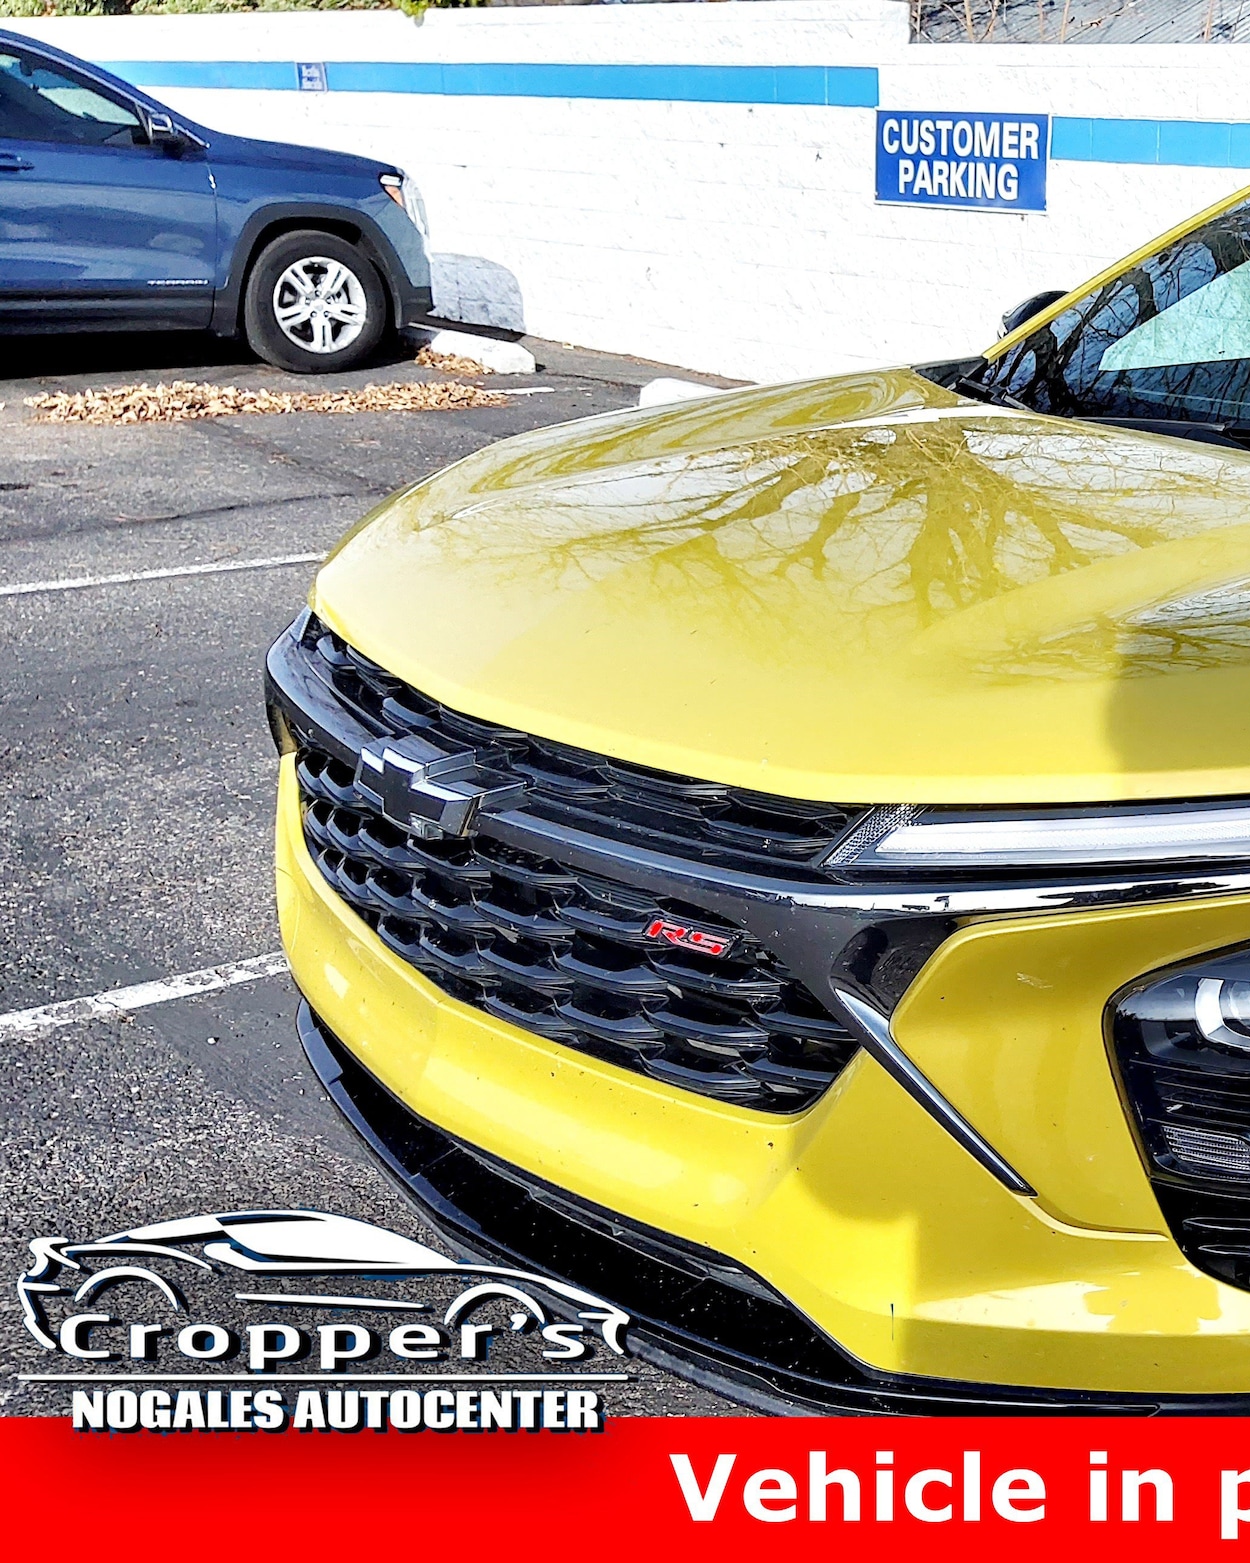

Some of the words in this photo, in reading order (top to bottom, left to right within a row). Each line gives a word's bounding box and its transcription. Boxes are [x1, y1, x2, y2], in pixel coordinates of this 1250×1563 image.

[882, 118, 1040, 160] CUSTOMER
[898, 159, 1019, 201] PARKING
[646, 919, 730, 956] RS
